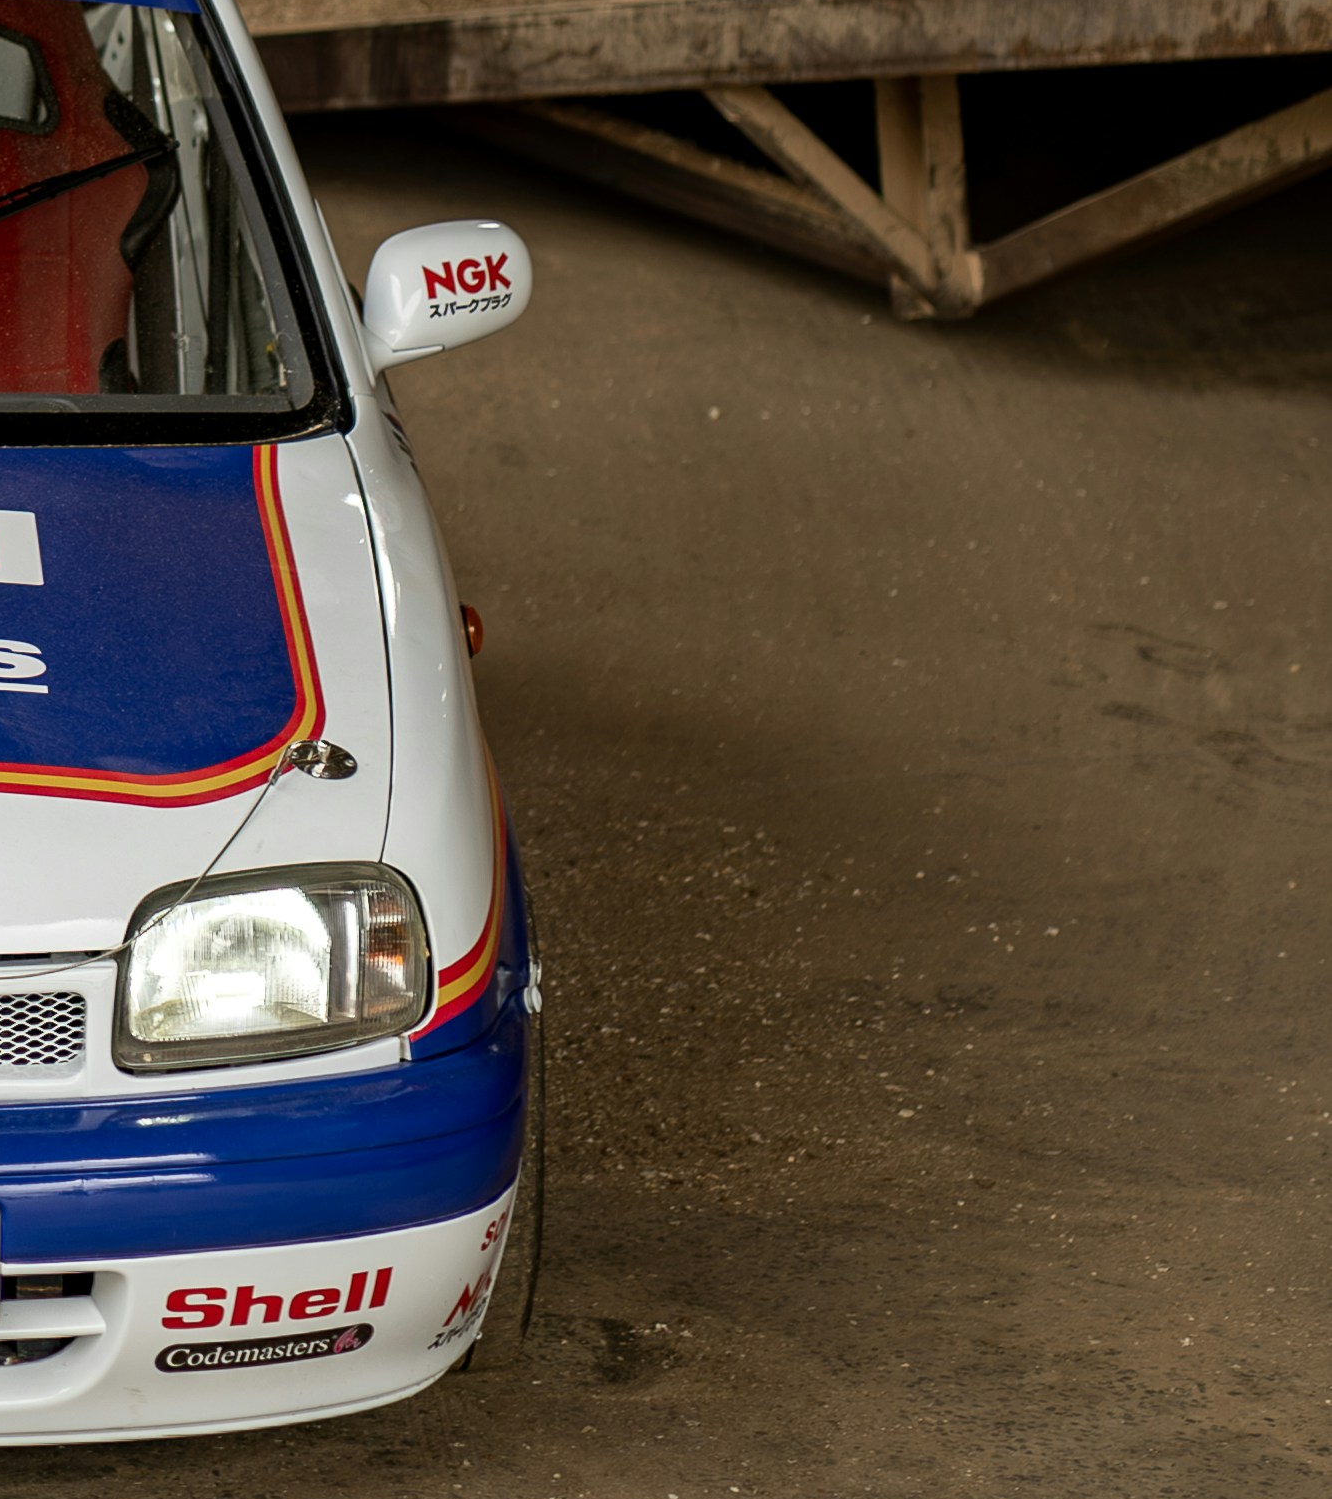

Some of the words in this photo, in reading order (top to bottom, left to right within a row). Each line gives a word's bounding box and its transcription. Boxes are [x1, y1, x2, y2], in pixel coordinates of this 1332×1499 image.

[421, 252, 512, 300] NGK
[429, 293, 512, 318] スパークプラグ
[161, 1266, 394, 1330] Shell
[166, 1335, 331, 1368] Codemasters
